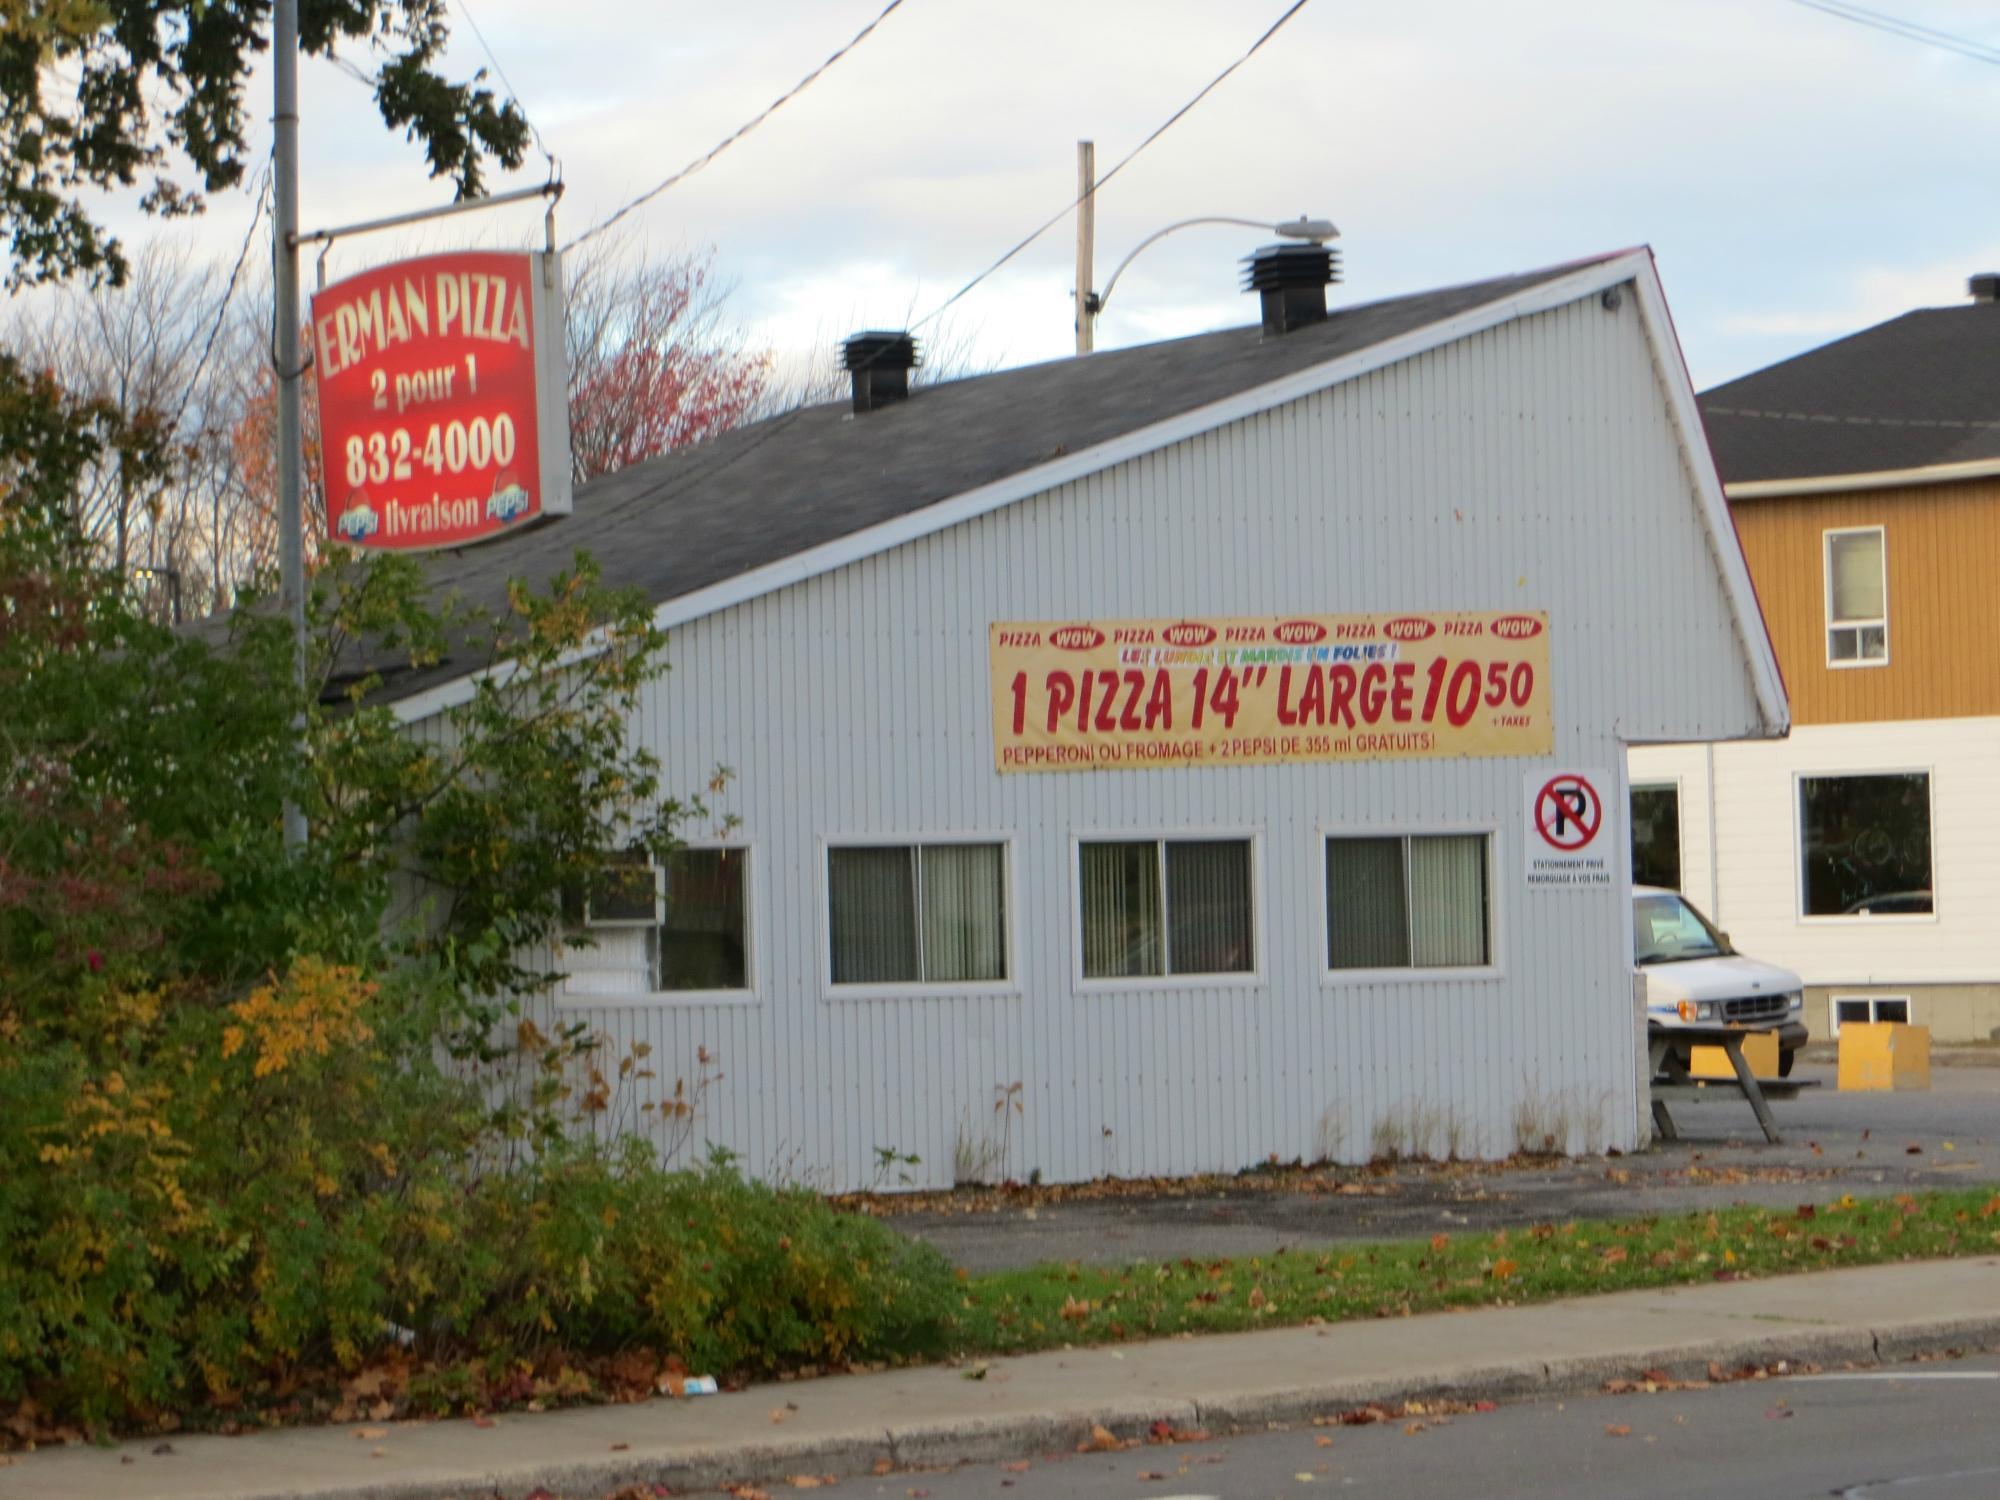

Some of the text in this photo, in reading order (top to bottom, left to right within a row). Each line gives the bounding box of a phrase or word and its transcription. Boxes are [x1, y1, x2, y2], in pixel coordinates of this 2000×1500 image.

[317, 272, 529, 380] ERMAN PIZZA
[371, 353, 478, 414] 2 pour 1
[346, 411, 516, 488] 832-4000
[386, 492, 479, 537] livraison
[486, 490, 529, 520] PEPSI
[337, 511, 379, 535] PEPSI
[999, 616, 1536, 649] PIZZA WOW PIZZA WOW PIZZA WOW PIZZA WOW PIZZA WOW
[1011, 669, 1028, 736] 1
[1045, 667, 1173, 734] PIZZA
[1276, 661, 1416, 730] LARGE
[1500, 715, 1531, 728] TAXES
[1003, 743, 1095, 764] PEPPERONI
[1100, 742, 1121, 762] OU
[1127, 740, 1203, 760] FROMAGE
[1221, 740, 1230, 757] 2
[1232, 736, 1276, 757] PEPSI
[1280, 736, 1300, 754] DE
[1306, 735, 1331, 754] 355
[1533, 860, 1584, 870] STATIONNEMENT
[1592, 872, 1610, 883] FRAIS
